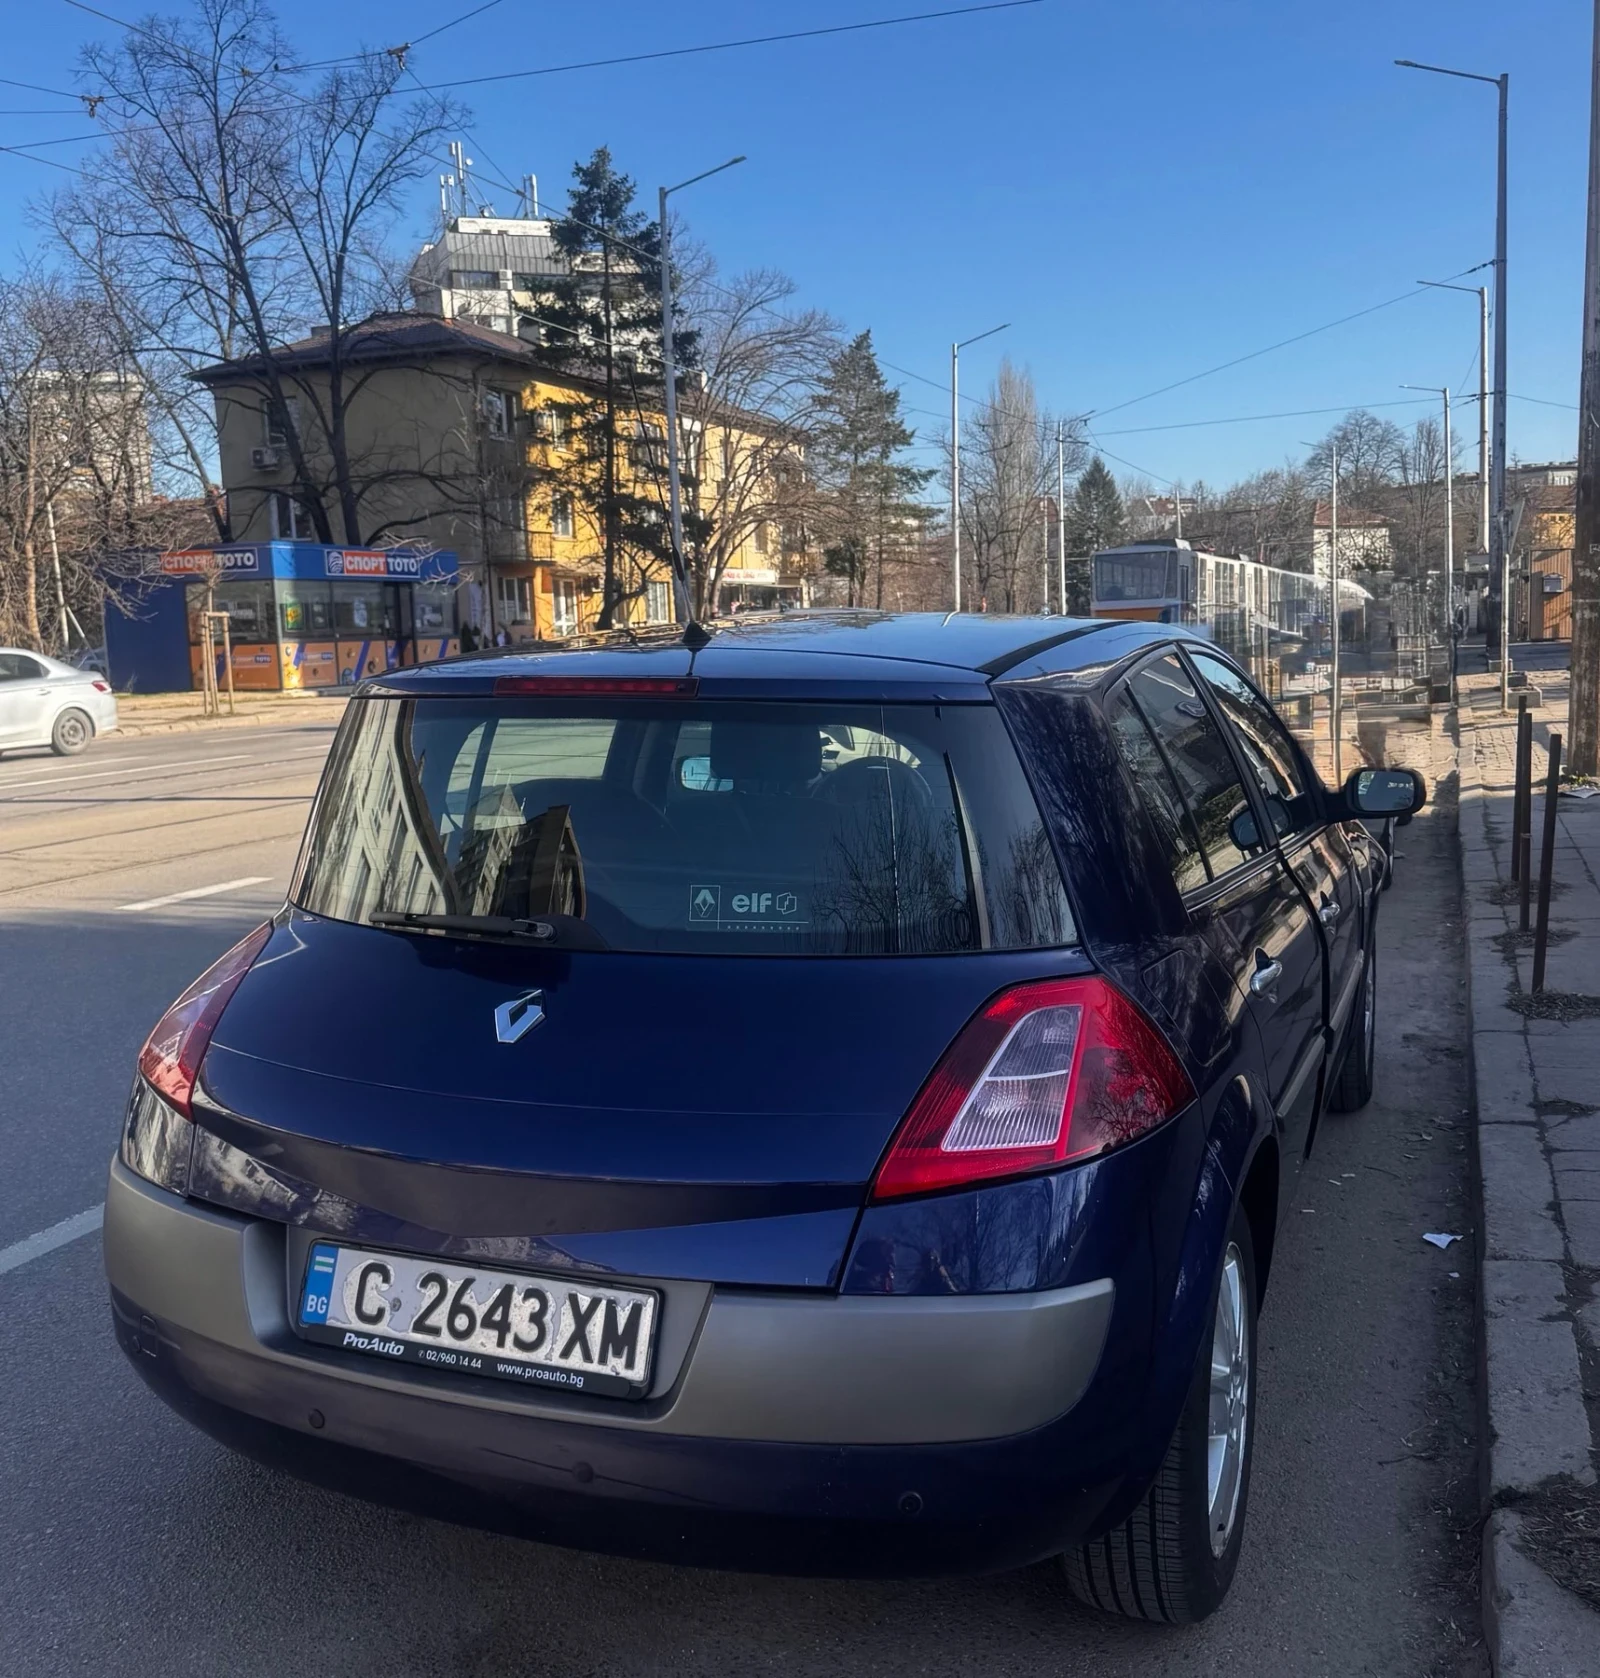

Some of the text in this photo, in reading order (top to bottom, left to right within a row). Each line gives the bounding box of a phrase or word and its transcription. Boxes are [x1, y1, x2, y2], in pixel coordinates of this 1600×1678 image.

[346, 556, 417, 572] СПОРТ ТОТО
[732, 893, 772, 913] elf
[306, 1294, 328, 1315] BG
[411, 1272, 549, 1353] 2643
[559, 1292, 643, 1371] XM
[343, 1332, 584, 1388] ProAuto 02/960 14 44 www.proauto.bg
